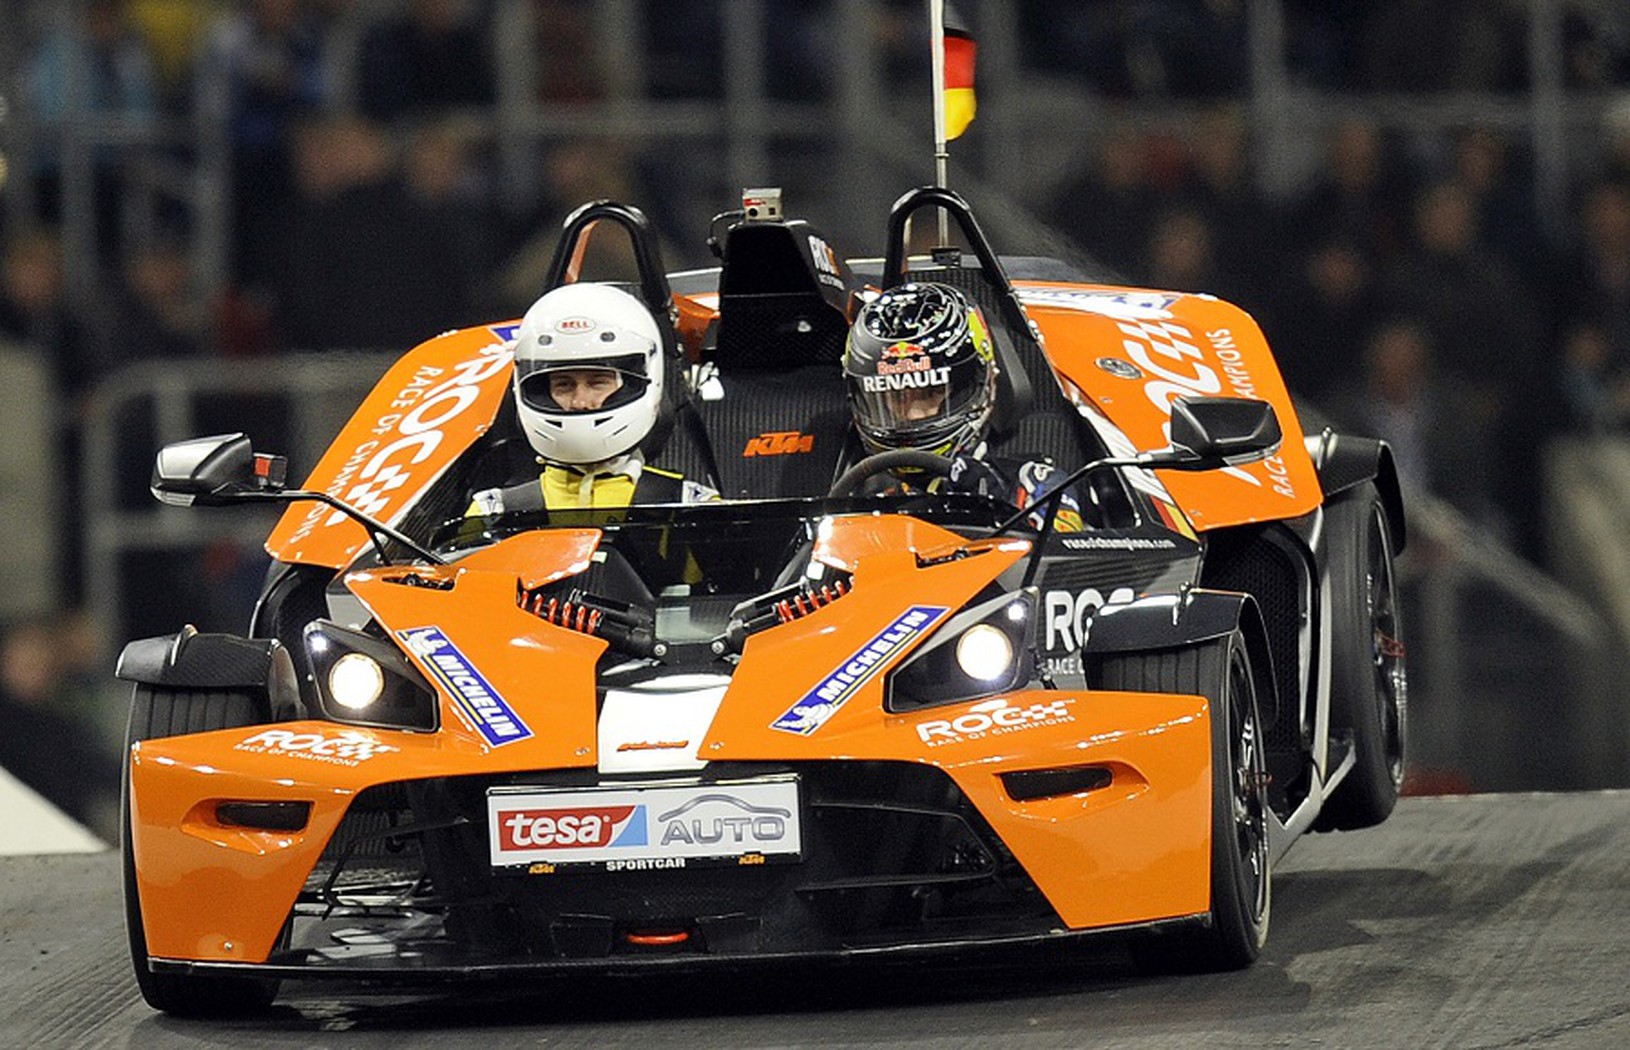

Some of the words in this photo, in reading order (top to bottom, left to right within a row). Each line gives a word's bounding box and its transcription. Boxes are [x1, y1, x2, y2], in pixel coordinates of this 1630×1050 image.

[561, 320, 591, 329] BELL
[877, 358, 904, 375] Red
[903, 356, 931, 373] Bull
[1205, 328, 1258, 399] AMPIONS
[391, 364, 444, 408] RACE
[863, 366, 952, 392] RENAULT
[371, 413, 402, 435] OF
[743, 431, 815, 457] KTM
[817, 610, 930, 701] MICHELIN
[431, 654, 521, 738] MICHELIN
[916, 706, 1030, 743] ROC
[927, 736, 964, 748] RACE
[968, 730, 987, 740] OF
[992, 714, 1077, 736] CHAMPIONS
[233, 743, 266, 753] RACE
[268, 747, 285, 755] OF
[288, 750, 360, 767] CHAMPIONS
[243, 729, 352, 757] ROC
[505, 813, 602, 846] tesa
[661, 815, 785, 845] AUTO
[606, 858, 686, 871] SPORTCAR
